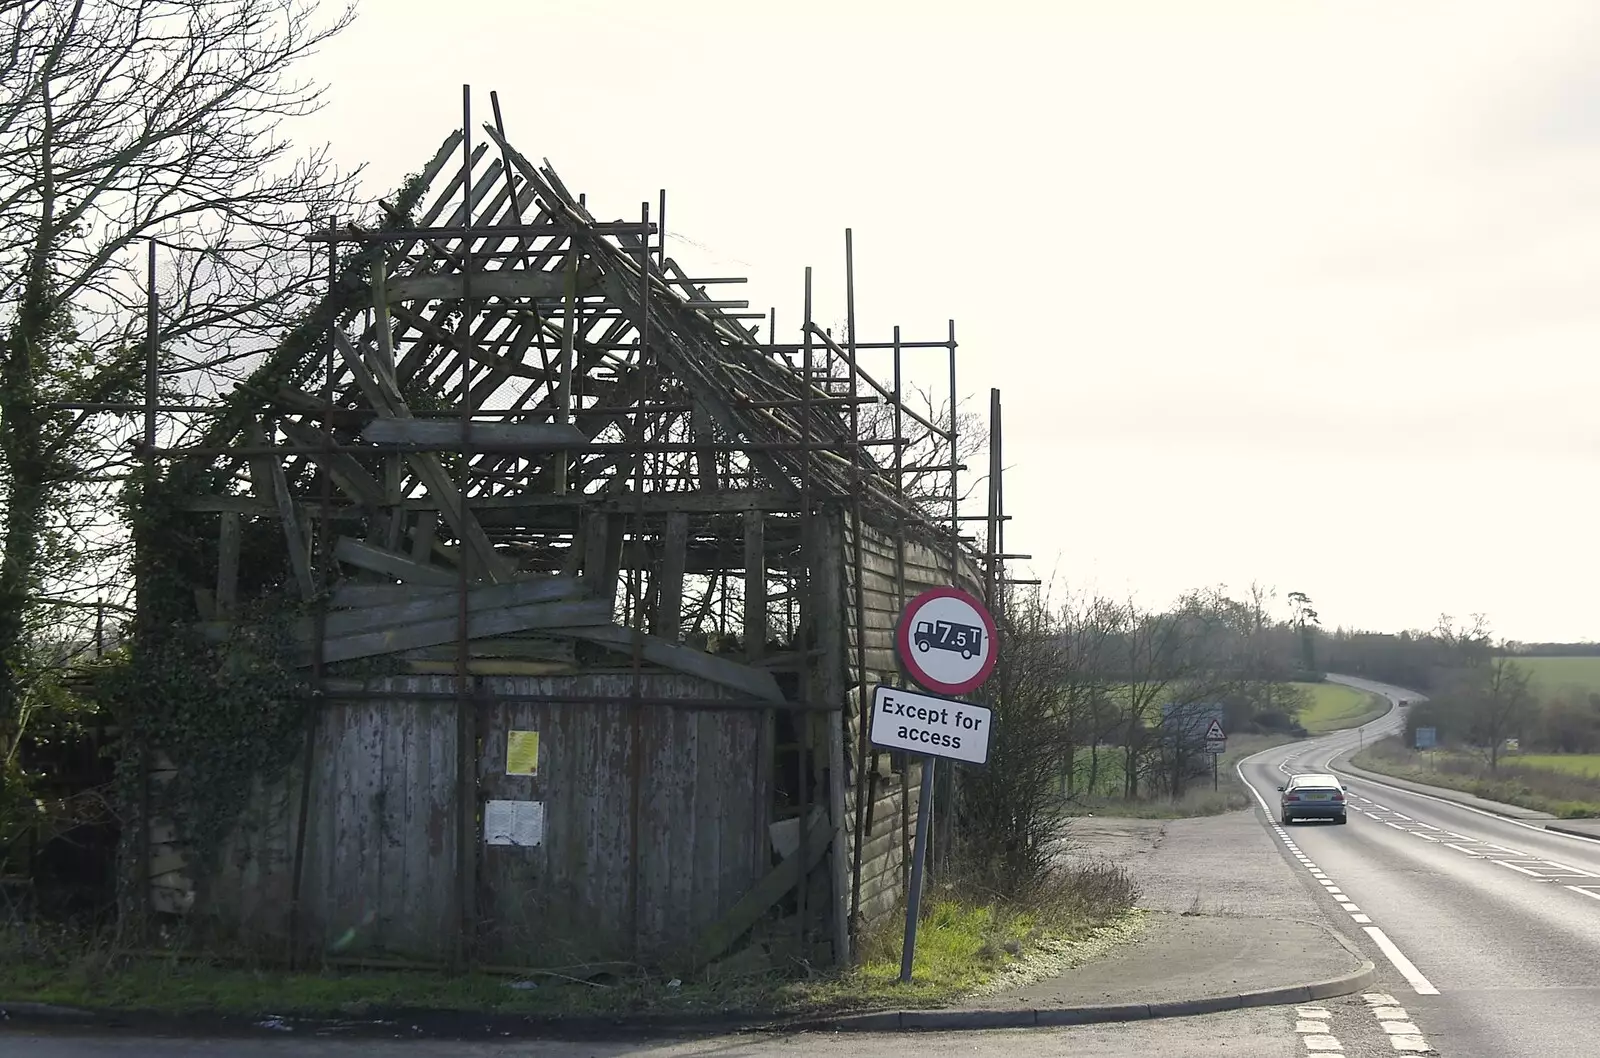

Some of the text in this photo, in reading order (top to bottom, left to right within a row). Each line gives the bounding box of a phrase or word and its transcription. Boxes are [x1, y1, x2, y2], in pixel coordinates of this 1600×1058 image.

[882, 696, 982, 731] Except for
[897, 725, 961, 749] access
